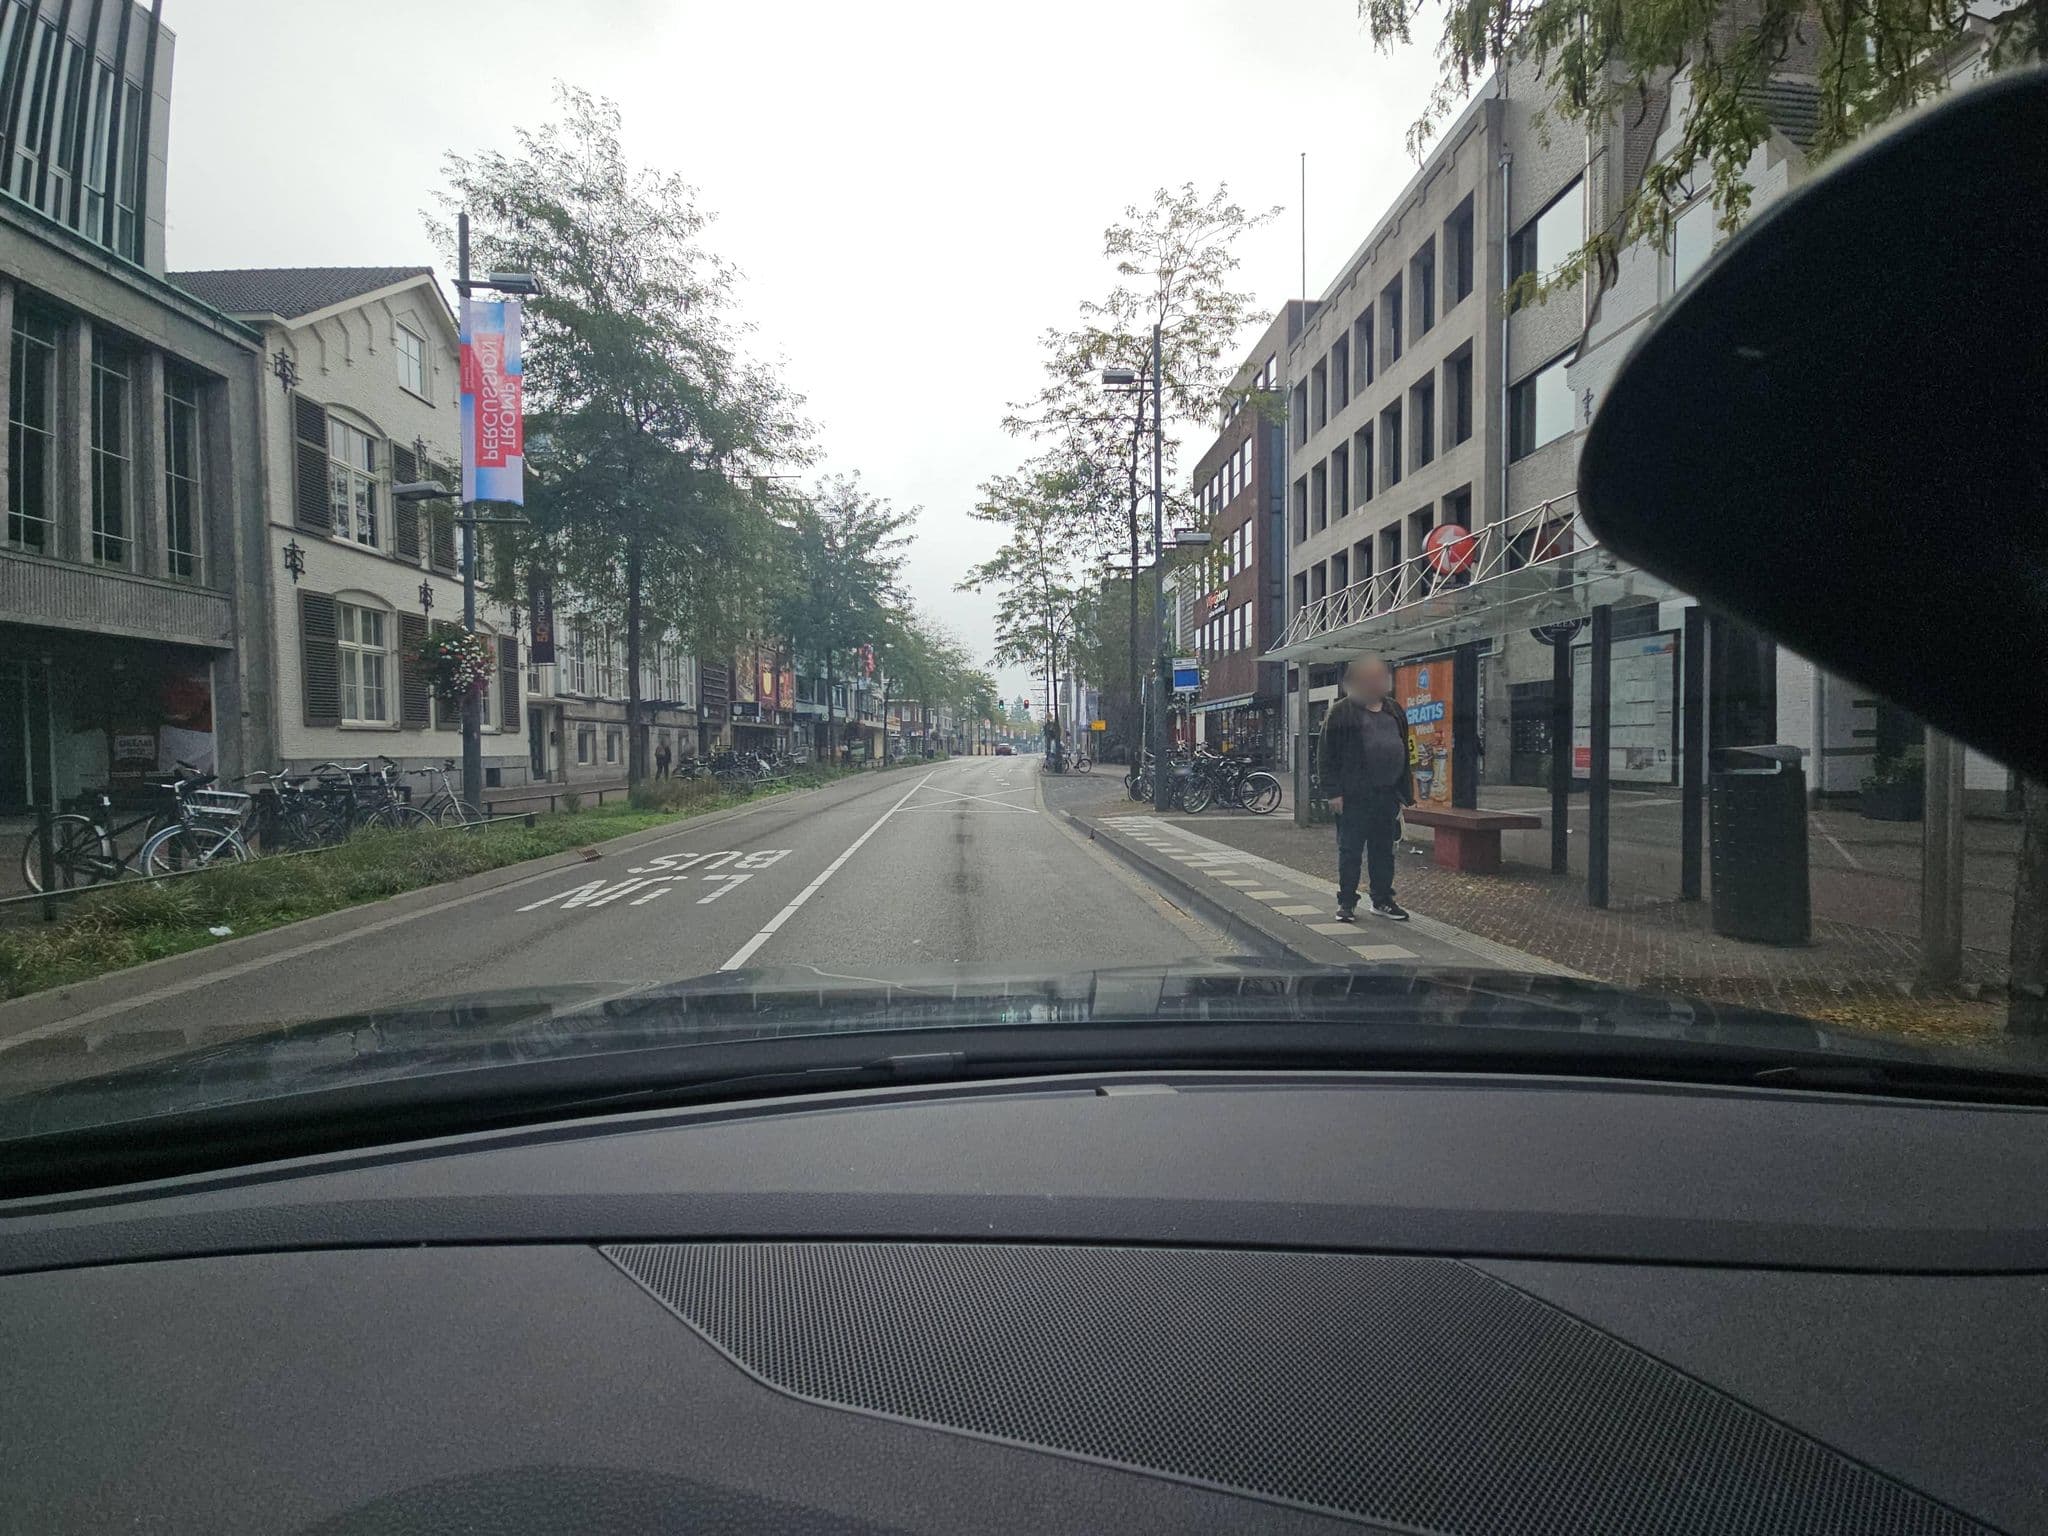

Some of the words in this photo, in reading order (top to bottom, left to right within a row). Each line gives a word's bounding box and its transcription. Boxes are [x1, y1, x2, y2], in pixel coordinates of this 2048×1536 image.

[1406, 702, 1444, 725] GRATIS
[627, 849, 792, 874] BUS
[515, 873, 755, 912] LIJN
